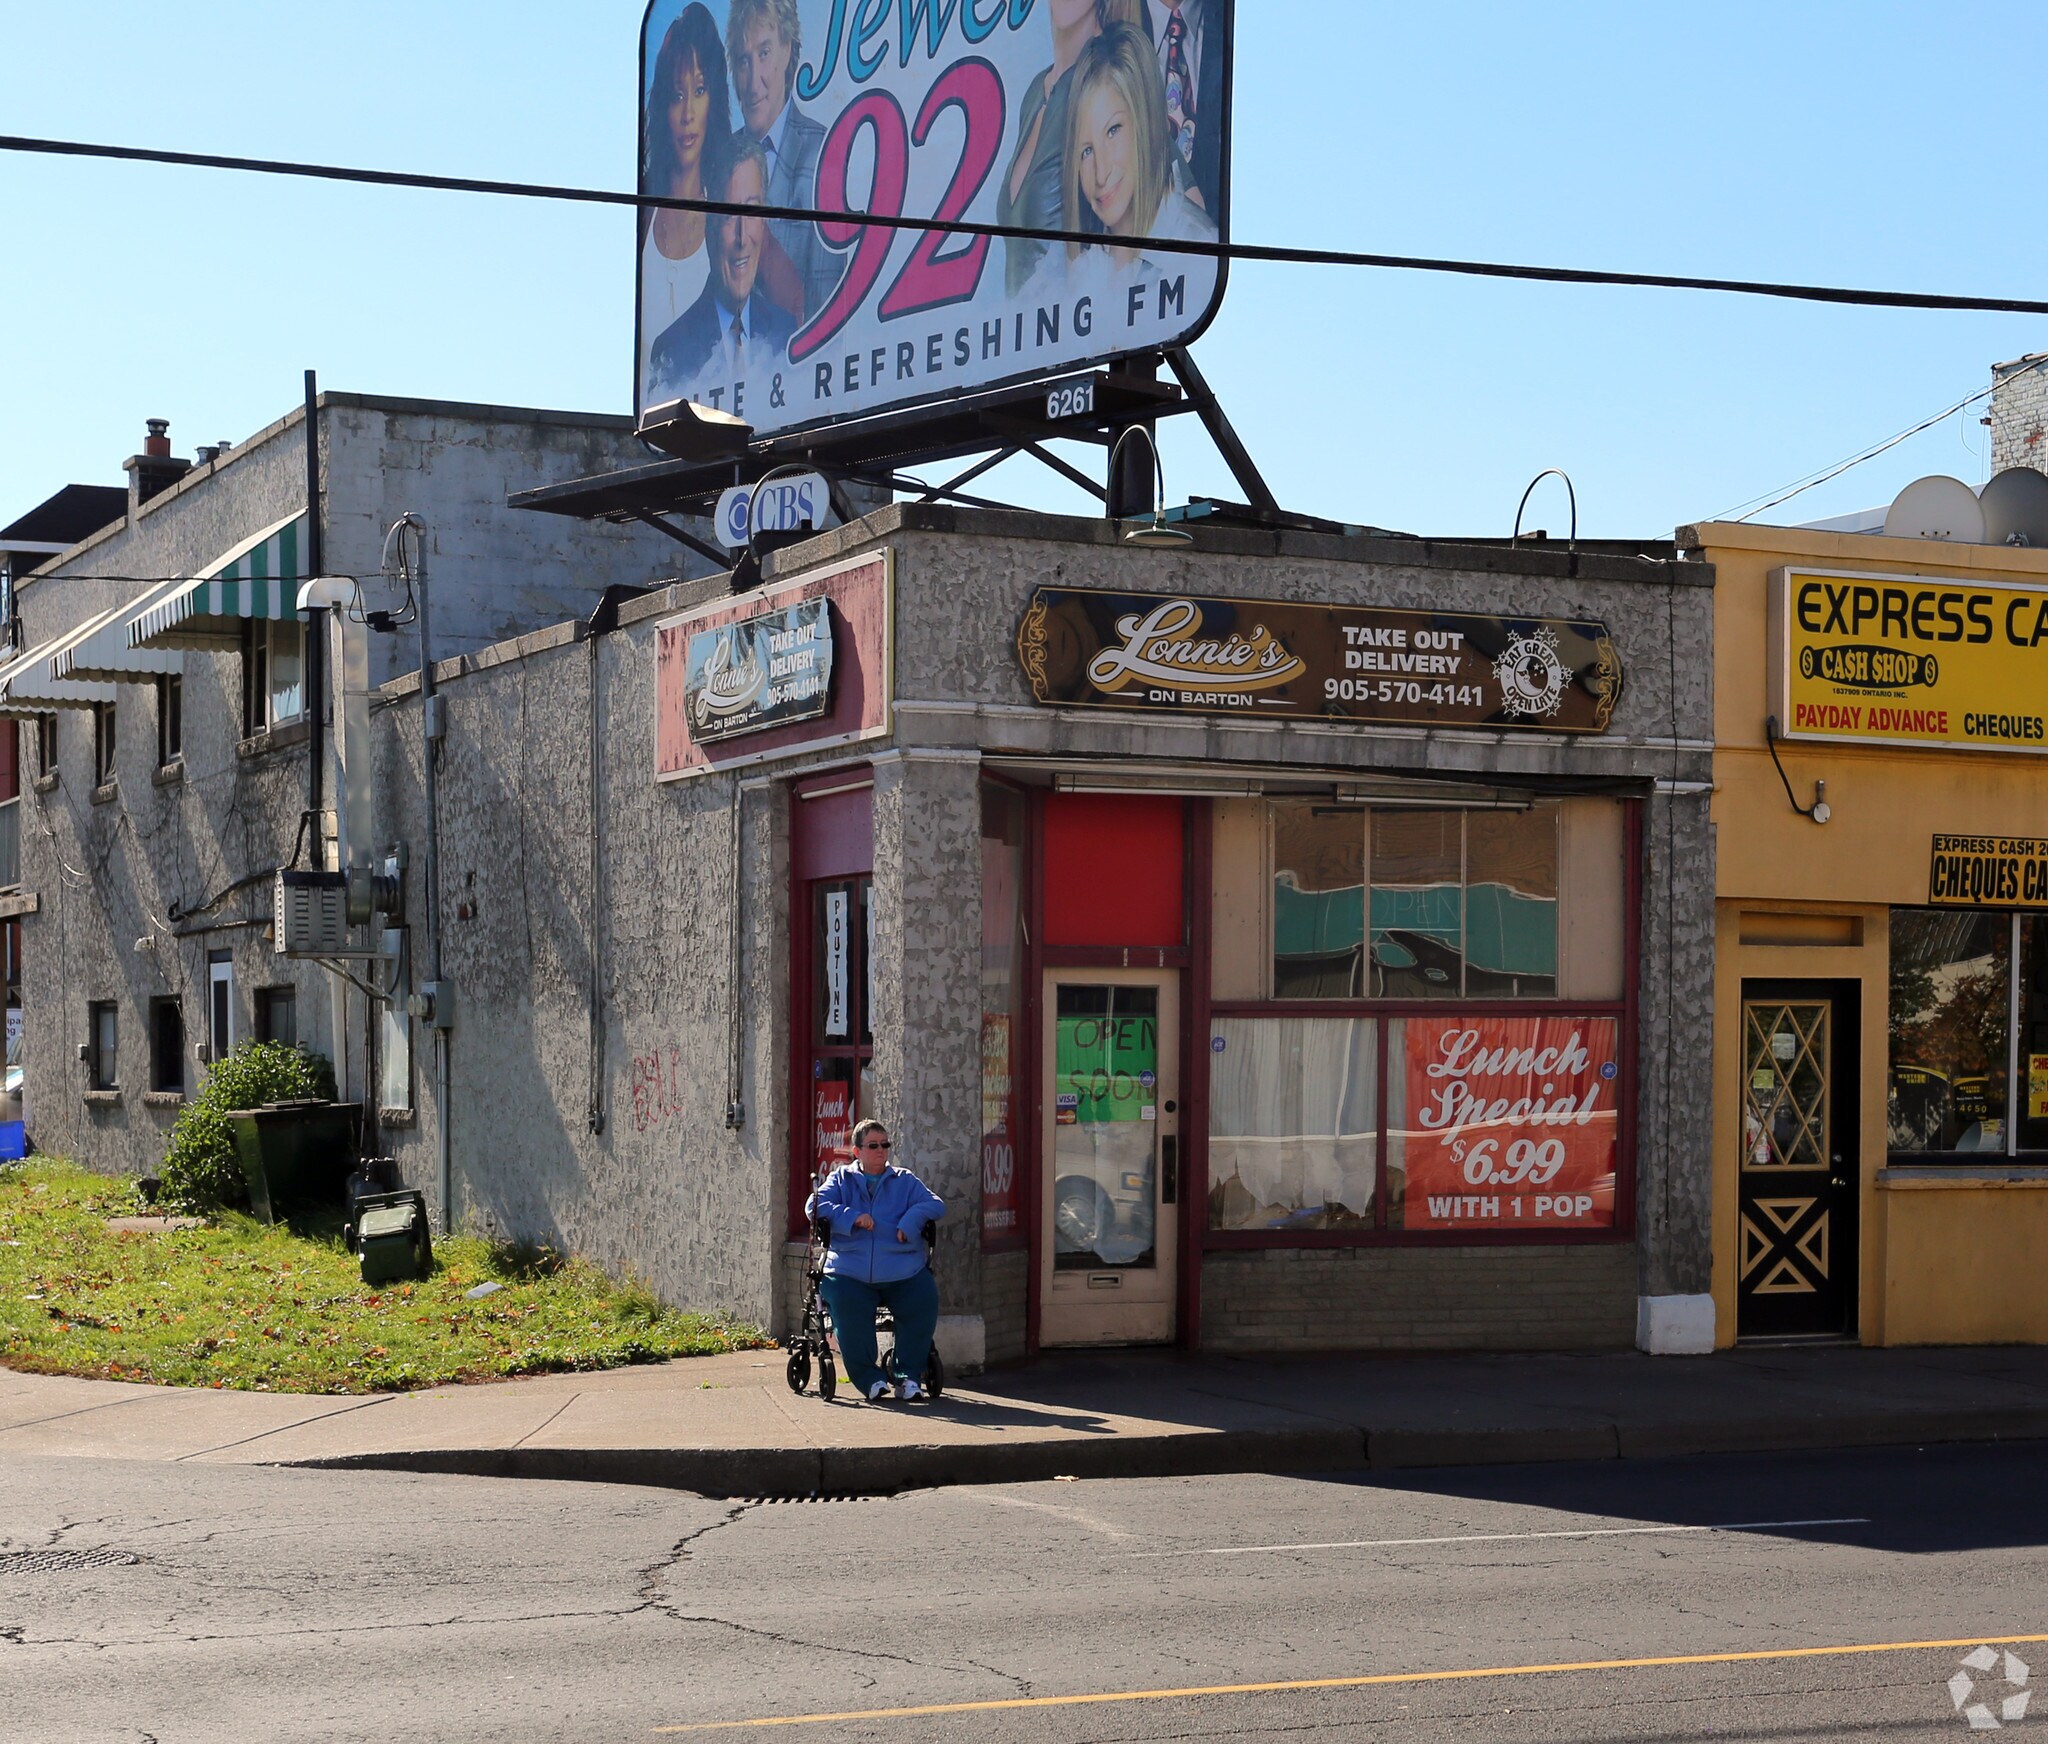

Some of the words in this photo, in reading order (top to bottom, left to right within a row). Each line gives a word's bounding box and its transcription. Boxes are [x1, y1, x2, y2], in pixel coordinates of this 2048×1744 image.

[790, 56, 1005, 363] 92
[770, 372, 786, 408] &
[814, 296, 1091, 399] REFRESHING
[1127, 274, 1185, 327] FM
[1046, 385, 1095, 420] 6261
[757, 481, 815, 531] CBS
[1797, 582, 1993, 644] EXPRESS
[769, 629, 795, 654] TAKE
[797, 623, 817, 647] OUT
[1088, 600, 1300, 688] Lonnie's
[1342, 626, 1407, 648] TAKE
[1414, 630, 1464, 650] OUT
[770, 648, 816, 678] DELIVERY
[1345, 650, 1462, 674] DELIVERY
[1504, 646, 1522, 669] EAT
[1524, 642, 1558, 669] GREAT
[767, 675, 819, 706] 905-570-4141
[1149, 689, 1176, 703] ON
[1181, 691, 1253, 706] BARTON
[1324, 678, 1483, 706] 905-570-4141
[1506, 685, 1533, 711] OPEN
[1534, 685, 1558, 711] LATE
[1862, 689, 1892, 698] ONTARIO
[1893, 691, 1908, 699] INC.
[713, 717, 723, 731] ON
[724, 712, 748, 729] BARTON
[1796, 703, 1862, 729] PAYDAY
[1867, 707, 1948, 734] ADVANCE
[1964, 712, 2044, 739] CHEQUES
[1935, 836, 1995, 854] EXPRESS
[2038, 842, 2048, 856] 2
[1932, 855, 2019, 902] CHEQUES
[832, 899, 842, 1025] POUTINE
[1074, 1018, 1156, 1051] OPEN
[1426, 1029, 1591, 1078] Lunch
[816, 1090, 844, 1119] Lunch
[1058, 1095, 1076, 1103] VISA
[1419, 1080, 1600, 1146] Special
[816, 1123, 846, 1158] Special
[1450, 1138, 1566, 1185] $6.99
[1427, 1196, 1500, 1218] WITH
[1510, 1196, 1522, 1218] 1
[1535, 1196, 1593, 1218] POP
